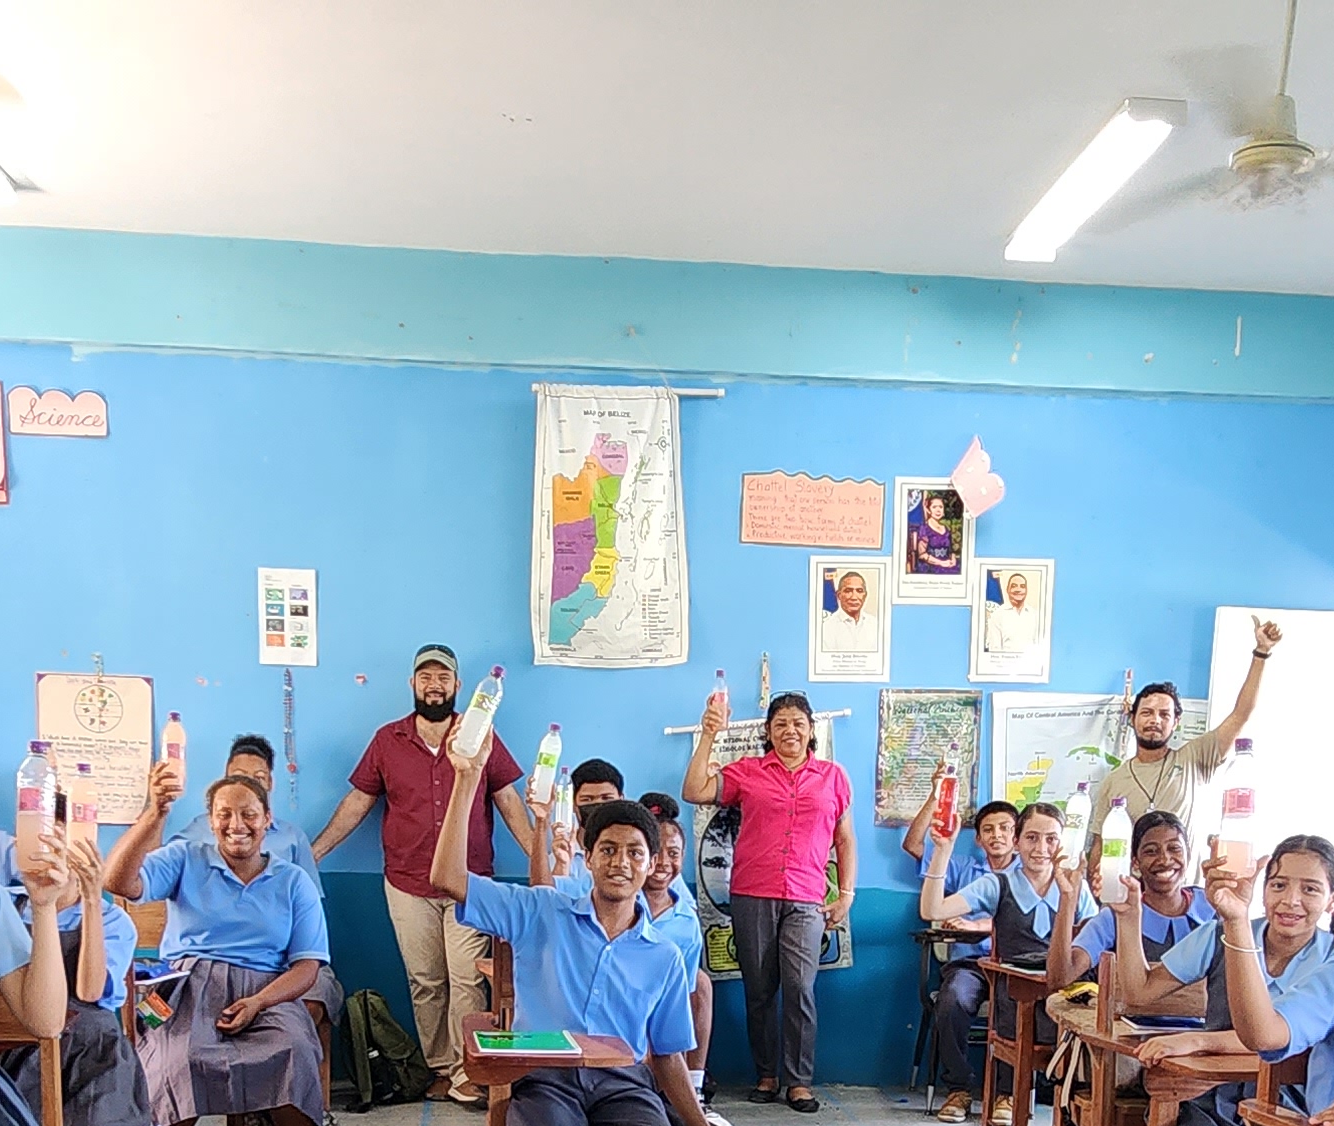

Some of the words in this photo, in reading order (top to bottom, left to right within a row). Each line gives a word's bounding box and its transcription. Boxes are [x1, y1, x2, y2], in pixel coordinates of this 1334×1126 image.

[19, 397, 104, 427] Science
[747, 478, 787, 492] Chattel
[795, 480, 835, 498] Slavery
